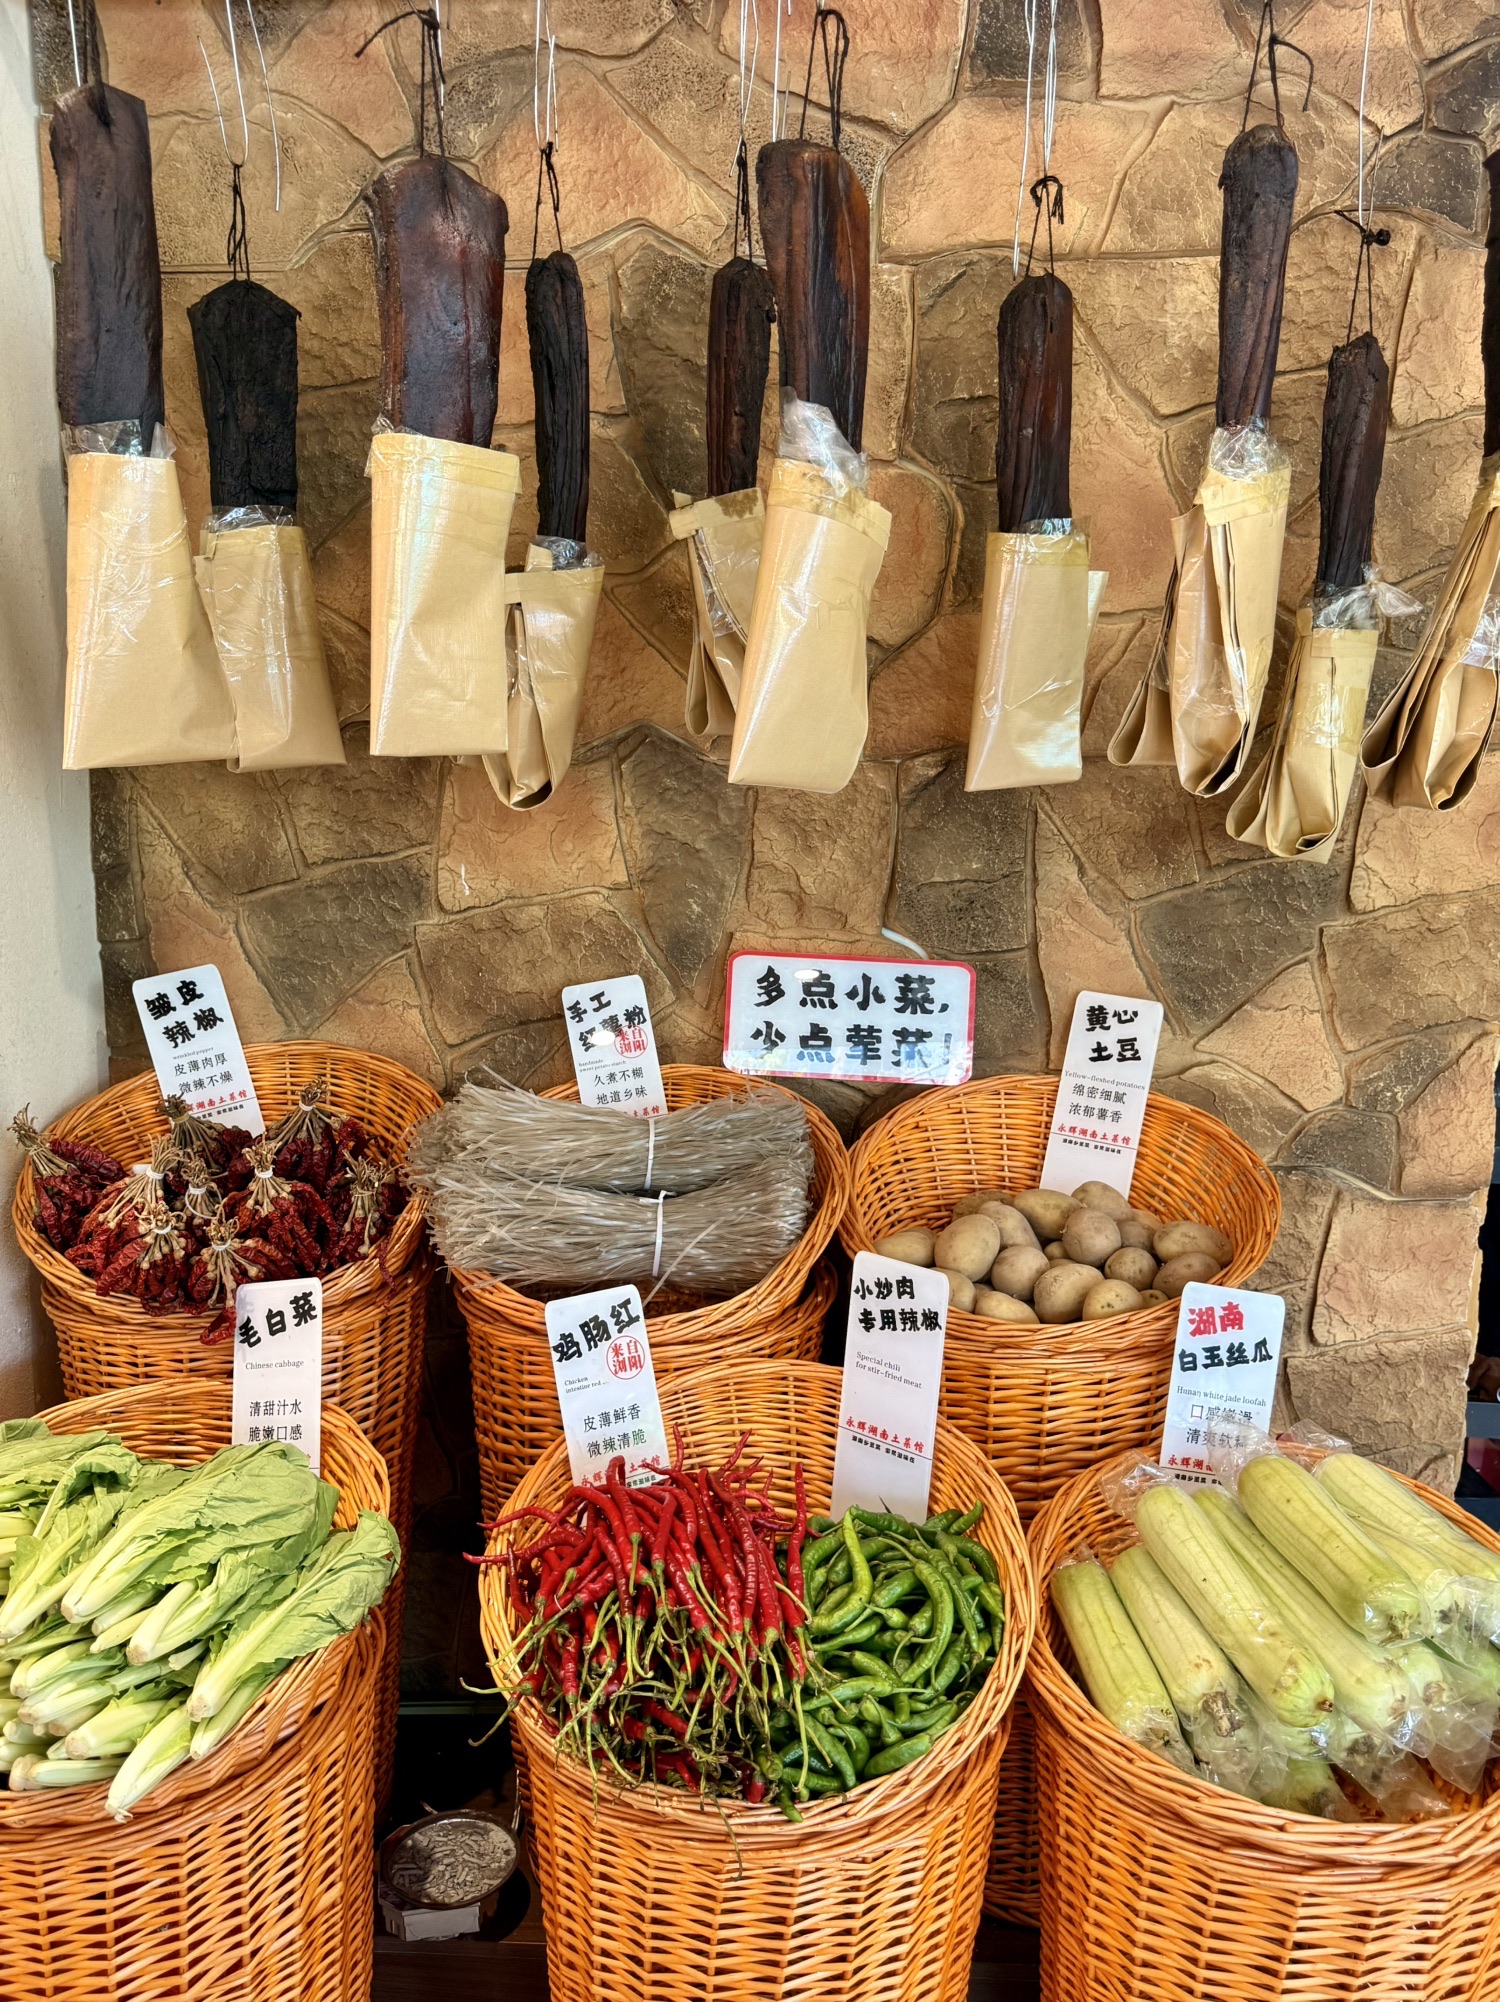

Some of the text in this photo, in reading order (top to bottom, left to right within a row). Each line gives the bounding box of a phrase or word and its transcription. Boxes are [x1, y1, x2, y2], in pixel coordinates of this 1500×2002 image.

[144, 980, 204, 1021] 皱皮
[566, 990, 612, 1023] 手工
[162, 1007, 224, 1049] 辣椒
[1085, 1005, 1139, 1032] 黄心
[173, 1046, 214, 1060] wrinkled pepper
[1088, 1037, 1142, 1063] 土豆
[174, 1052, 229, 1077] 皮薄肉厚
[179, 1071, 234, 1094] 微辣不燥
[593, 1067, 644, 1087] 久煮不糊
[1064, 1070, 1146, 1091] Yellow-fleshed potatoes
[596, 1084, 648, 1105] 地道乡味
[1072, 1083, 1128, 1105] 绵密细腻
[1068, 1102, 1123, 1124] 浓郁薯香
[1057, 1123, 1132, 1146] 永辉湖南土菜馆
[853, 1275, 916, 1300] 小炒肉
[239, 1290, 318, 1348] 毛白菜
[552, 1297, 641, 1363] 鸡肠红
[858, 1307, 943, 1333] 专用辣椒
[1187, 1301, 1245, 1337] 湖南
[611, 1339, 639, 1359] 来自
[1178, 1337, 1273, 1373] 白玉丝瓜
[245, 1359, 304, 1370] Chinese cabbage
[612, 1354, 644, 1375] 浏阳
[856, 1351, 901, 1372] Special chili
[564, 1377, 588, 1386] Chicken
[855, 1360, 923, 1389] for stir-fried meat
[565, 1383, 591, 1394] intestine
[1177, 1385, 1267, 1407] Hunan white jade loofah
[249, 1398, 302, 1417] 清甜汁水
[583, 1403, 642, 1433] 皮薄鲜香
[248, 1424, 303, 1443] 脆嫩口感
[587, 1428, 647, 1458] 微辣清脆
[846, 1416, 925, 1453] 永辉湖南土菜馆
[581, 1454, 661, 1487] 永辉土菜馆
